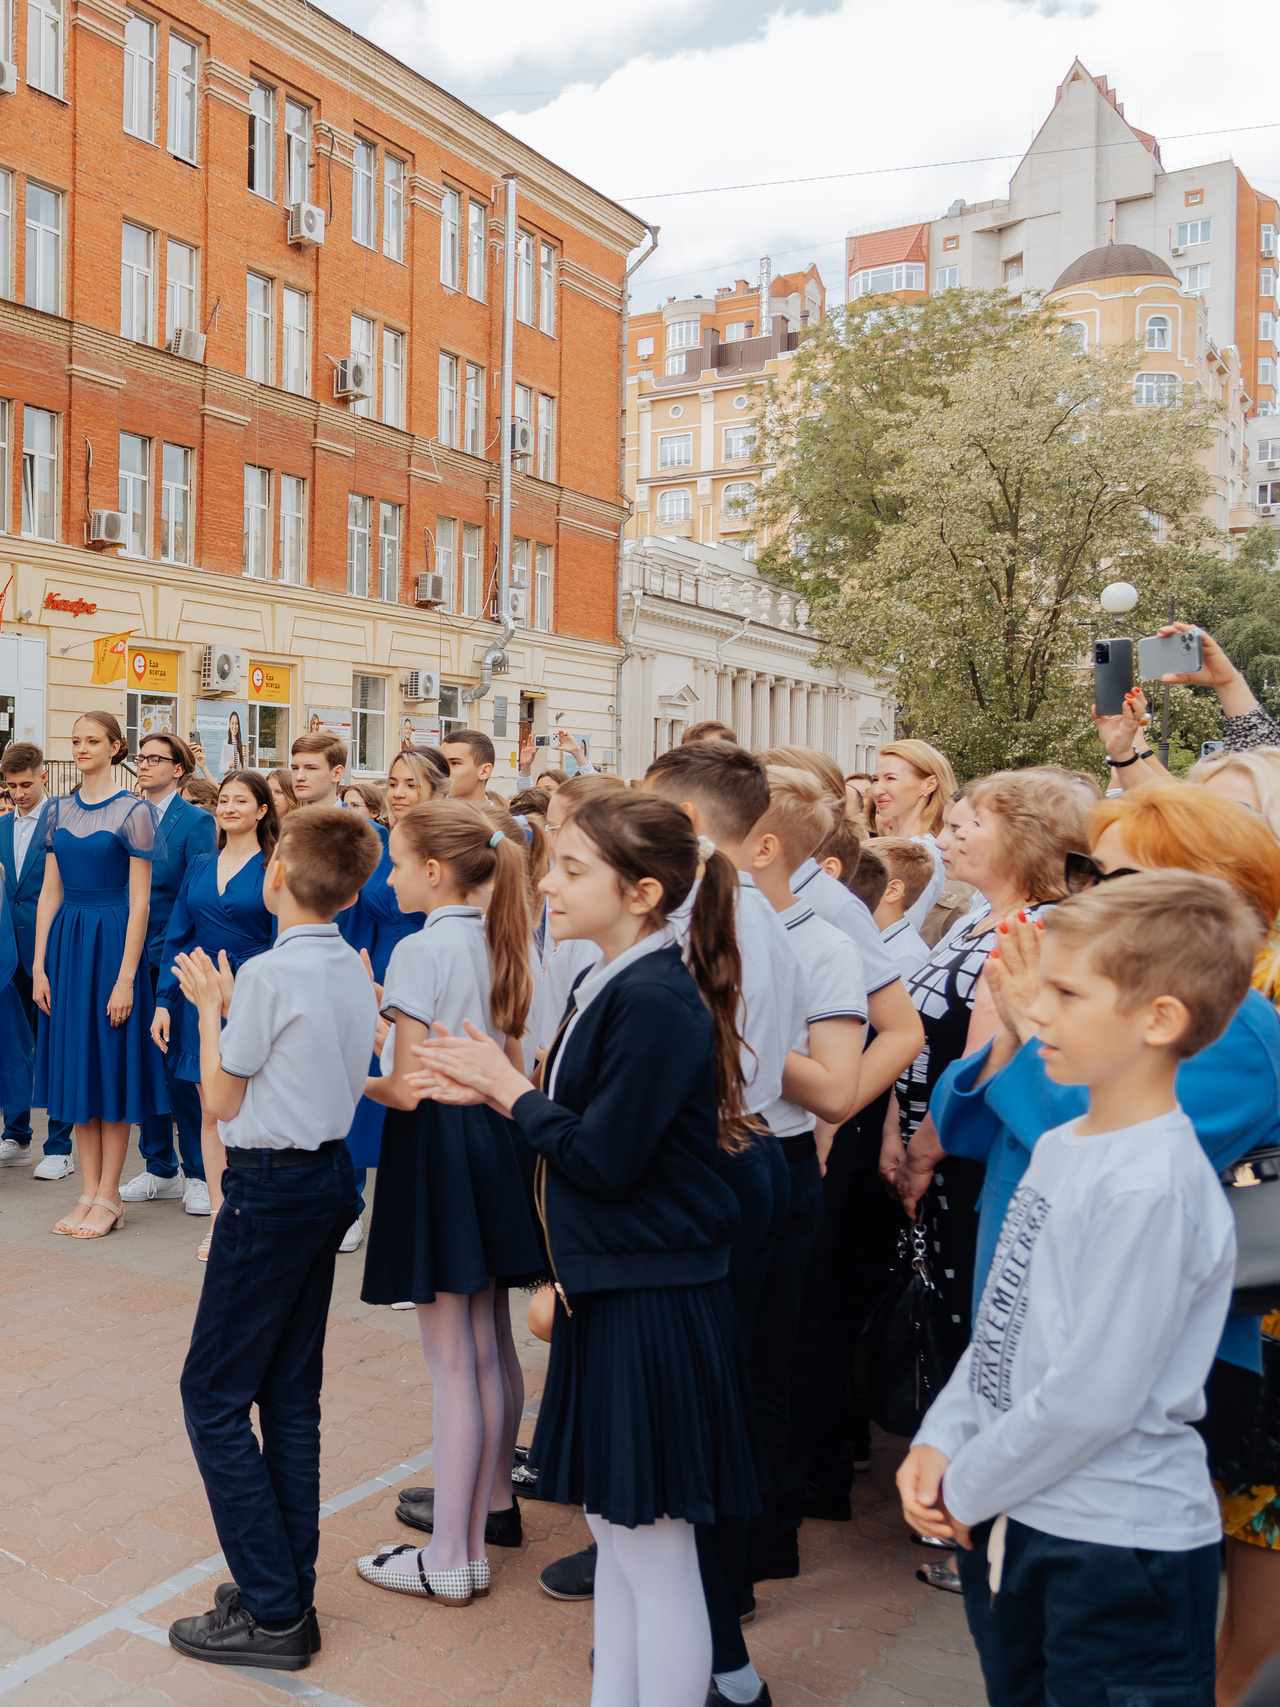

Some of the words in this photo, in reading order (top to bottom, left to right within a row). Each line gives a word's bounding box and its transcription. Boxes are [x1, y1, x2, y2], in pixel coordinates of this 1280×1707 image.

[44, 592, 98, 618] Кафе
[149, 659, 159, 668] Еда
[149, 669, 167, 677] всегда
[265, 673, 274, 681] Еда
[265, 682, 281, 690] всегда
